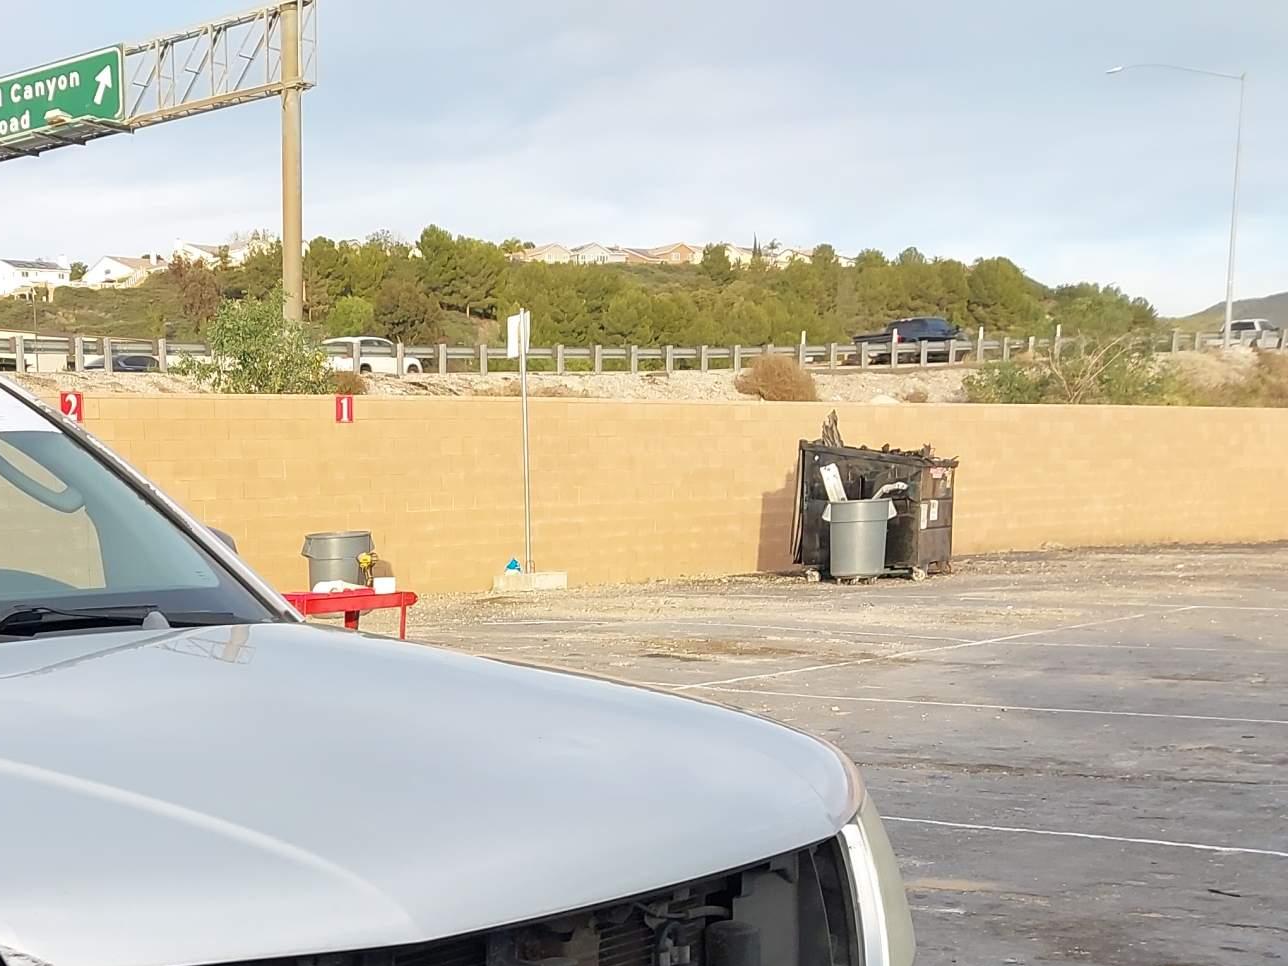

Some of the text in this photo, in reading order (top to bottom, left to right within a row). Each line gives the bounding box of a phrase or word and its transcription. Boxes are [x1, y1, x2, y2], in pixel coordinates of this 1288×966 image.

[10, 71, 80, 102] Canyon
[65, 393, 77, 421] 2
[340, 397, 349, 422] 1
